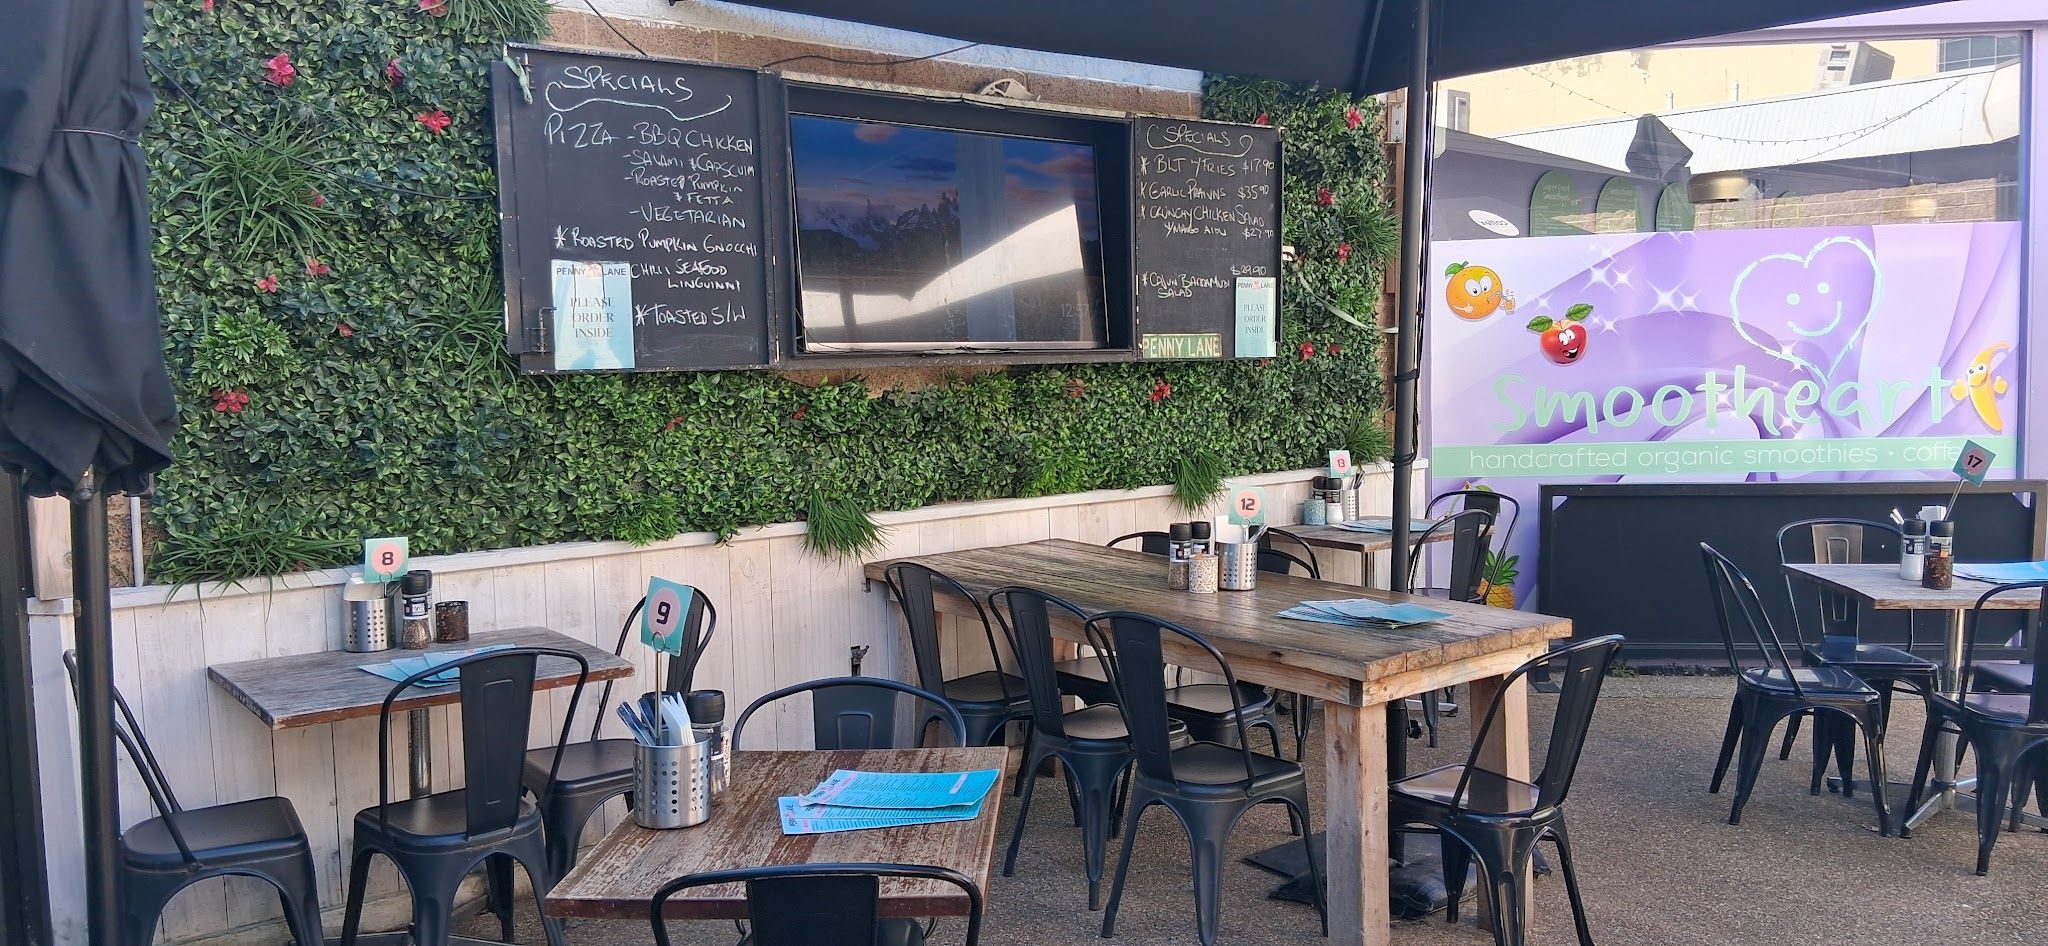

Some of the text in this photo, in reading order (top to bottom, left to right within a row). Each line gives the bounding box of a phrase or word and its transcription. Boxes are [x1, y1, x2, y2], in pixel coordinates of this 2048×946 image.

[564, 66, 692, 102] SPECIALS
[544, 113, 619, 148] PIZZA
[685, 130, 754, 155] CHICKEN
[1163, 123, 1231, 147] SPECIALS
[1154, 154, 1187, 174] BLT
[686, 192, 734, 205] FETTA
[1149, 181, 1186, 200] GARLIC
[1193, 204, 1235, 222] CHICKEN
[1235, 204, 1265, 227] SALAD
[572, 227, 634, 251] ROASTED
[703, 234, 758, 257] GNOCCHI
[556, 267, 628, 277] PENNY LANE
[675, 257, 728, 277] SEAFOOD
[1158, 287, 1193, 299] SALAD
[570, 297, 615, 309] PLEASE
[573, 312, 614, 323] ORDER
[648, 302, 747, 326] TOASTED S/W
[574, 327, 614, 338] INSIDE
[1143, 337, 1221, 358] PENNY LANE
[1337, 458, 1345, 467] 13
[1470, 447, 1627, 470] handcrafted
[1638, 446, 1733, 473] organic
[1744, 442, 1878, 465] smoothies
[1967, 454, 1983, 468] 17
[1240, 498, 1255, 510] 12
[382, 552, 393, 565] 8
[656, 601, 671, 624] 9
